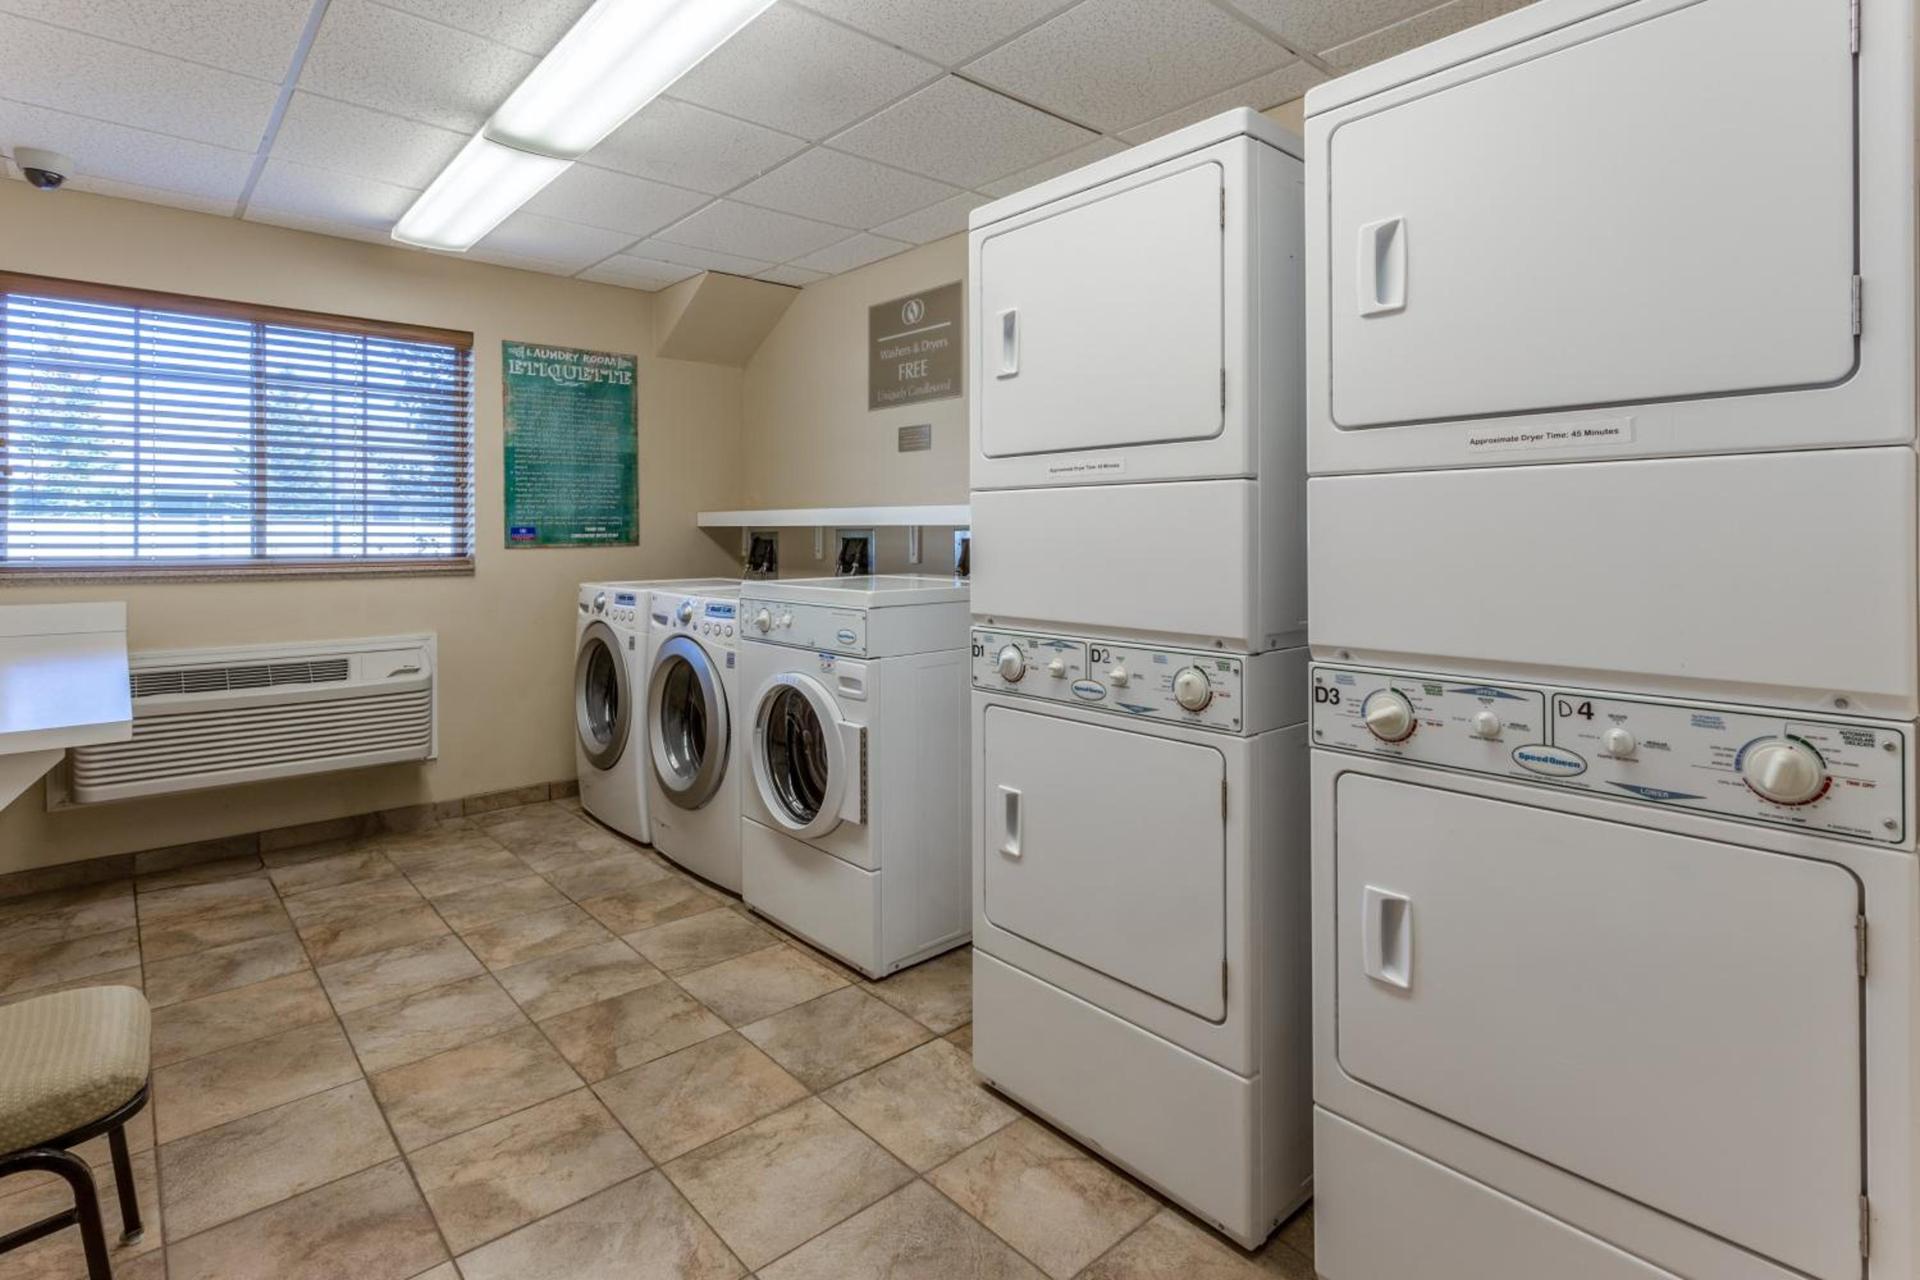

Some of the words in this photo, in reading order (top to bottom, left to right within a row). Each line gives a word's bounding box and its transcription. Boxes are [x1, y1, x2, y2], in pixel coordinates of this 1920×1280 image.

[526, 348, 579, 363] LAUNDRY
[583, 354, 616, 366] ROOM
[509, 359, 633, 386] ETIQUETTE
[898, 359, 928, 381] FREE
[1469, 434, 1519, 446] Approximate
[1521, 432, 1544, 443] Dryer
[1546, 430, 1569, 440] Time:
[1571, 429, 1582, 438] 45
[1584, 427, 1620, 437] Minutes
[972, 644, 984, 657] D1
[1091, 649, 1110, 664] D2
[1314, 685, 1340, 706] D3
[1518, 751, 1548, 764] Speed
[1549, 755, 1580, 768] Queen
